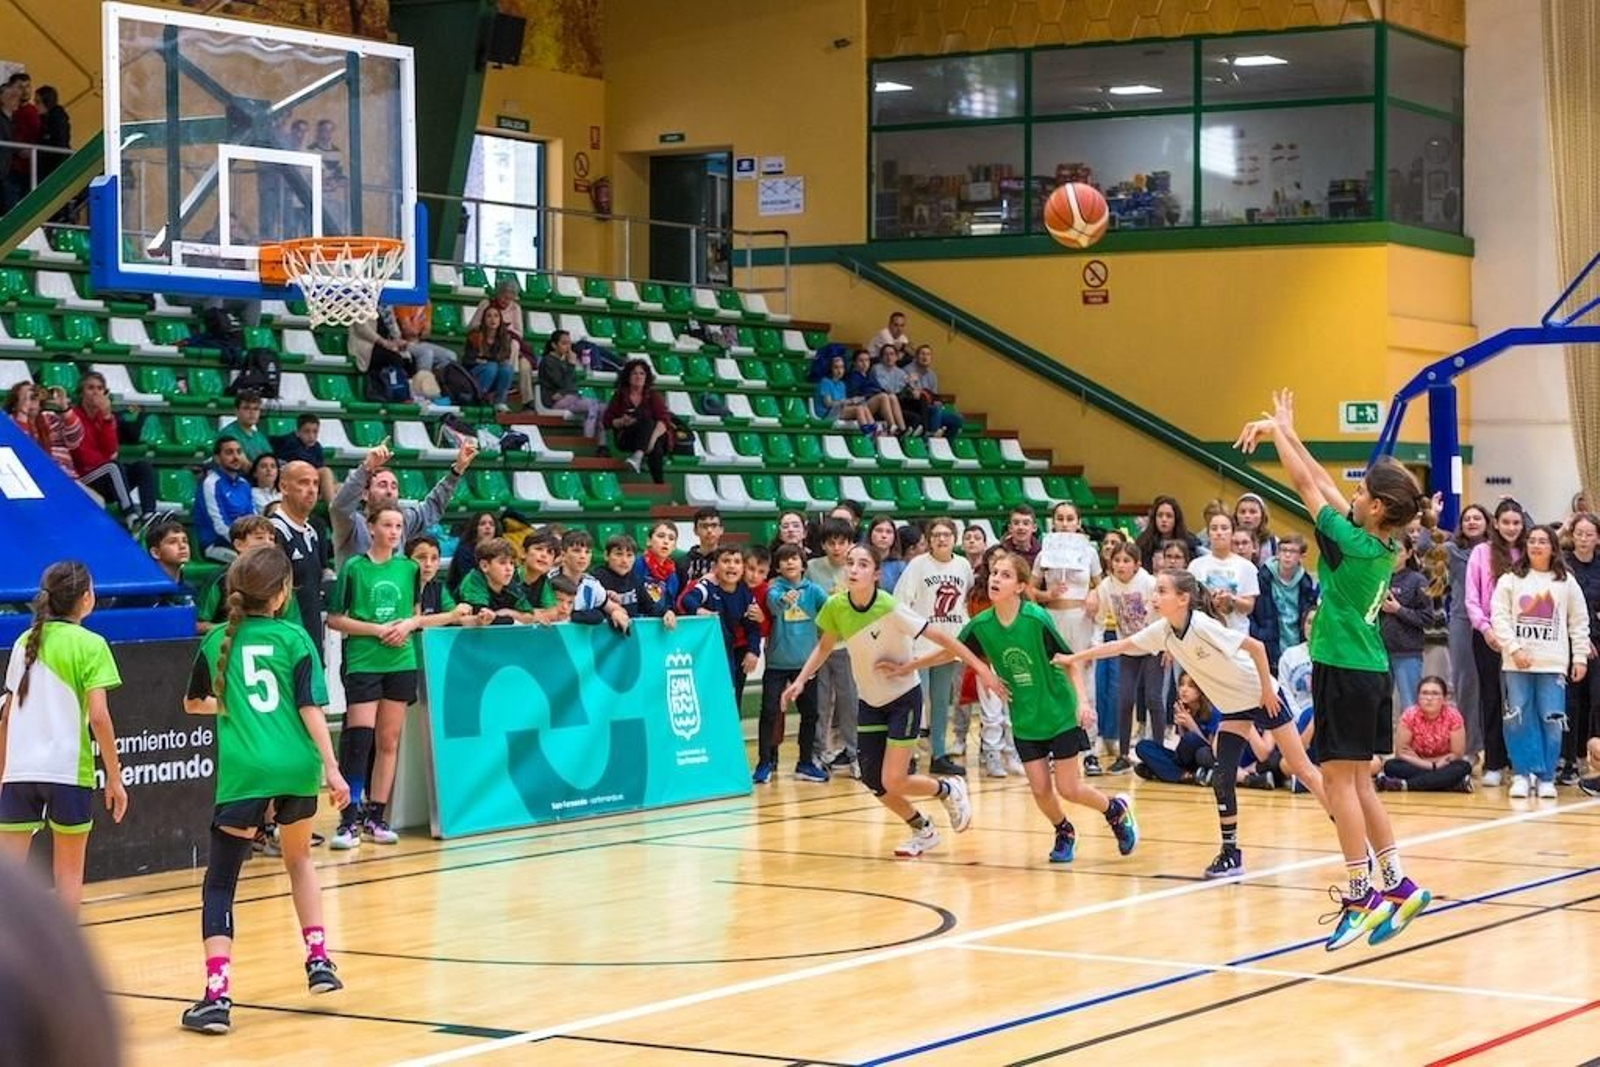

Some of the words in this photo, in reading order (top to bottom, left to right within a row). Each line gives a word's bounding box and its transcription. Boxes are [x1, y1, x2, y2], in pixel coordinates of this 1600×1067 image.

[242, 645, 280, 713] 5
[190, 725, 213, 747] de
[119, 753, 214, 787] ernando
